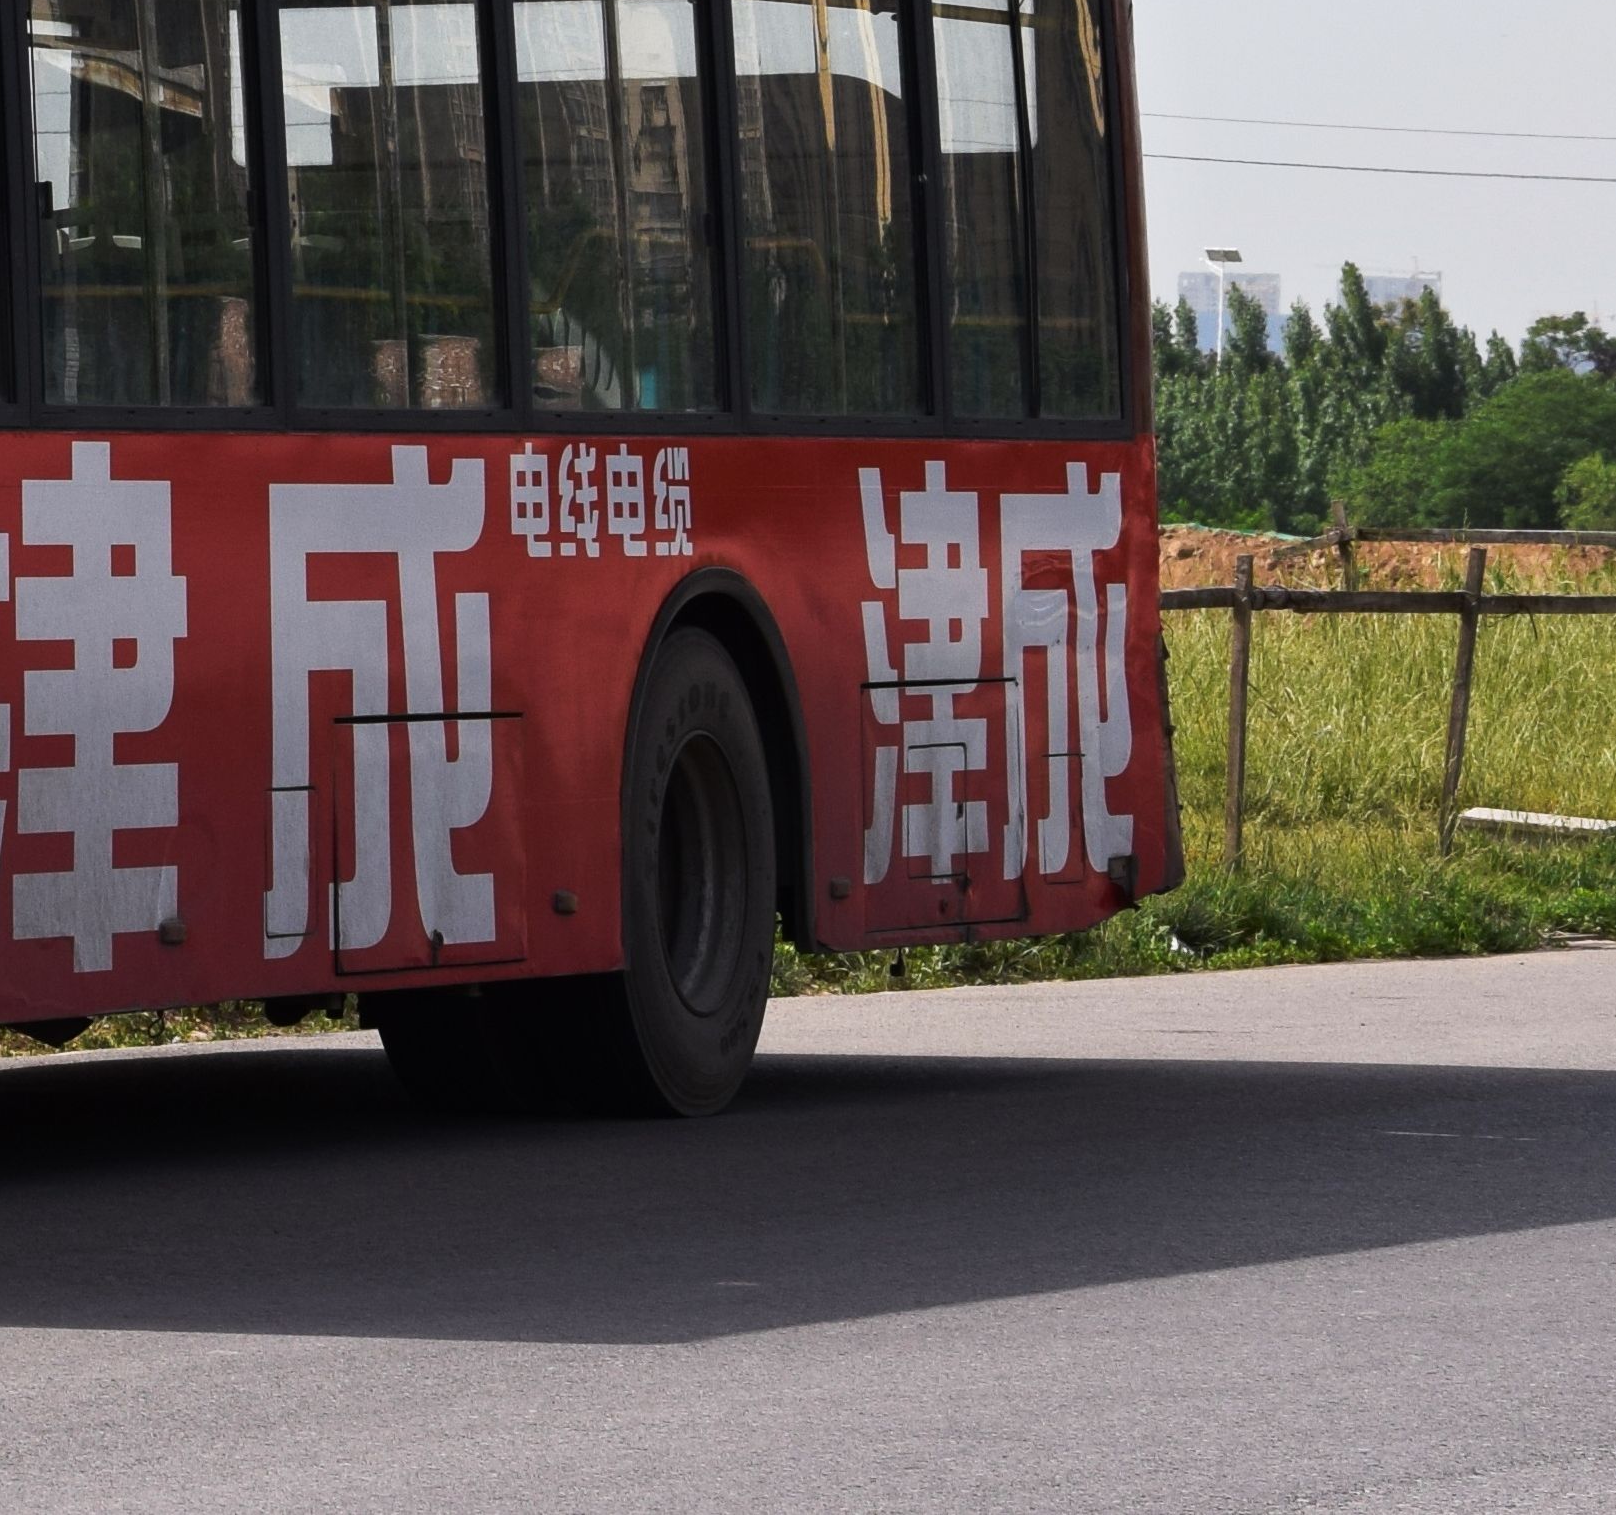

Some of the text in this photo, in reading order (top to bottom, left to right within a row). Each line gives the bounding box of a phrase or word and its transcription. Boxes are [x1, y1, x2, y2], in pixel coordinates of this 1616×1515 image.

[509, 442, 693, 558] 电线电缆
[859, 459, 1135, 886] 津成
